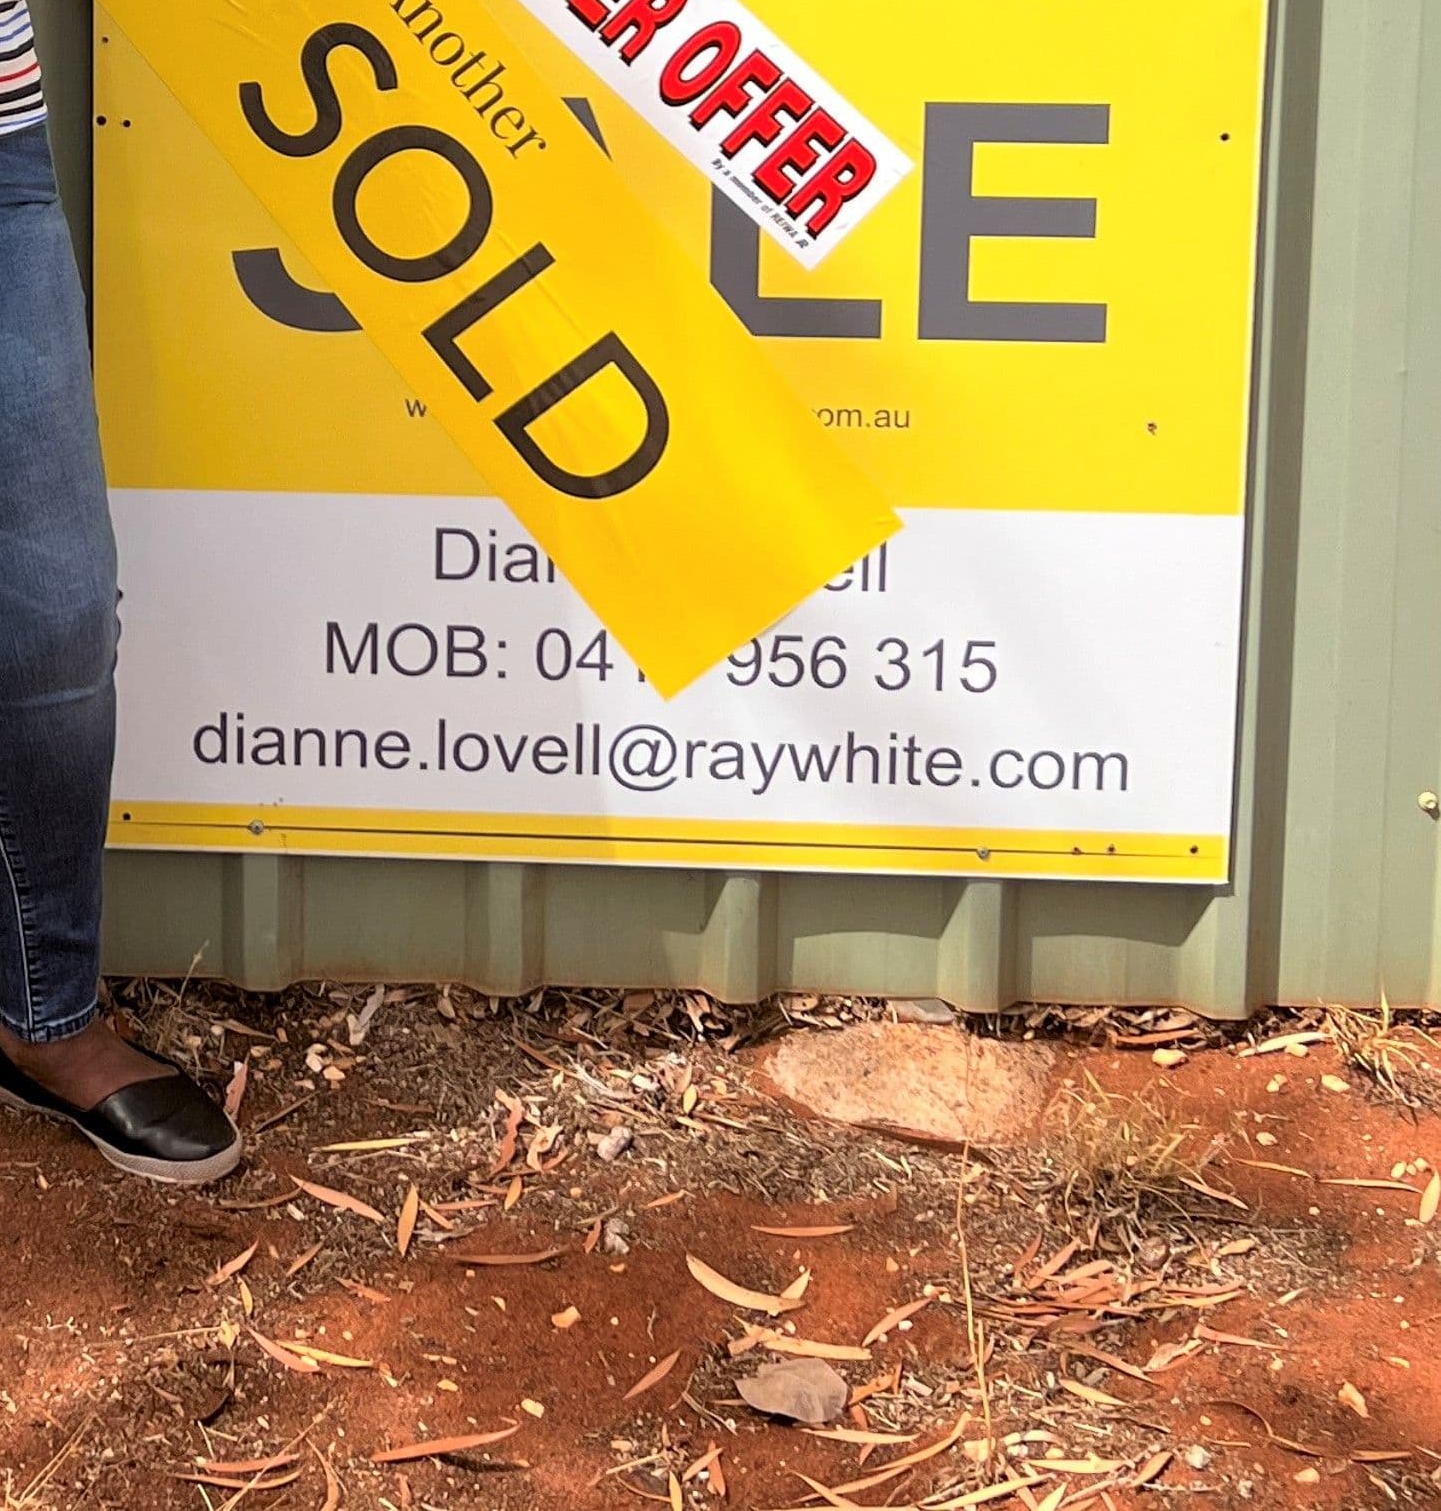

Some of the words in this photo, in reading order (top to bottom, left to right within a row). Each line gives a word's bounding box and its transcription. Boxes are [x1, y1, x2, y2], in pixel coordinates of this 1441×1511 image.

[659, 21, 877, 240] OFFER
[239, 22, 670, 499] SOLD
[435, 527, 555, 583] Dia
[325, 622, 507, 679] MOB:
[535, 627, 646, 682] 04
[726, 635, 847, 689] 956
[874, 637, 997, 693] 315
[192, 713, 1128, 794] dianne.lovell@raywhite.com
